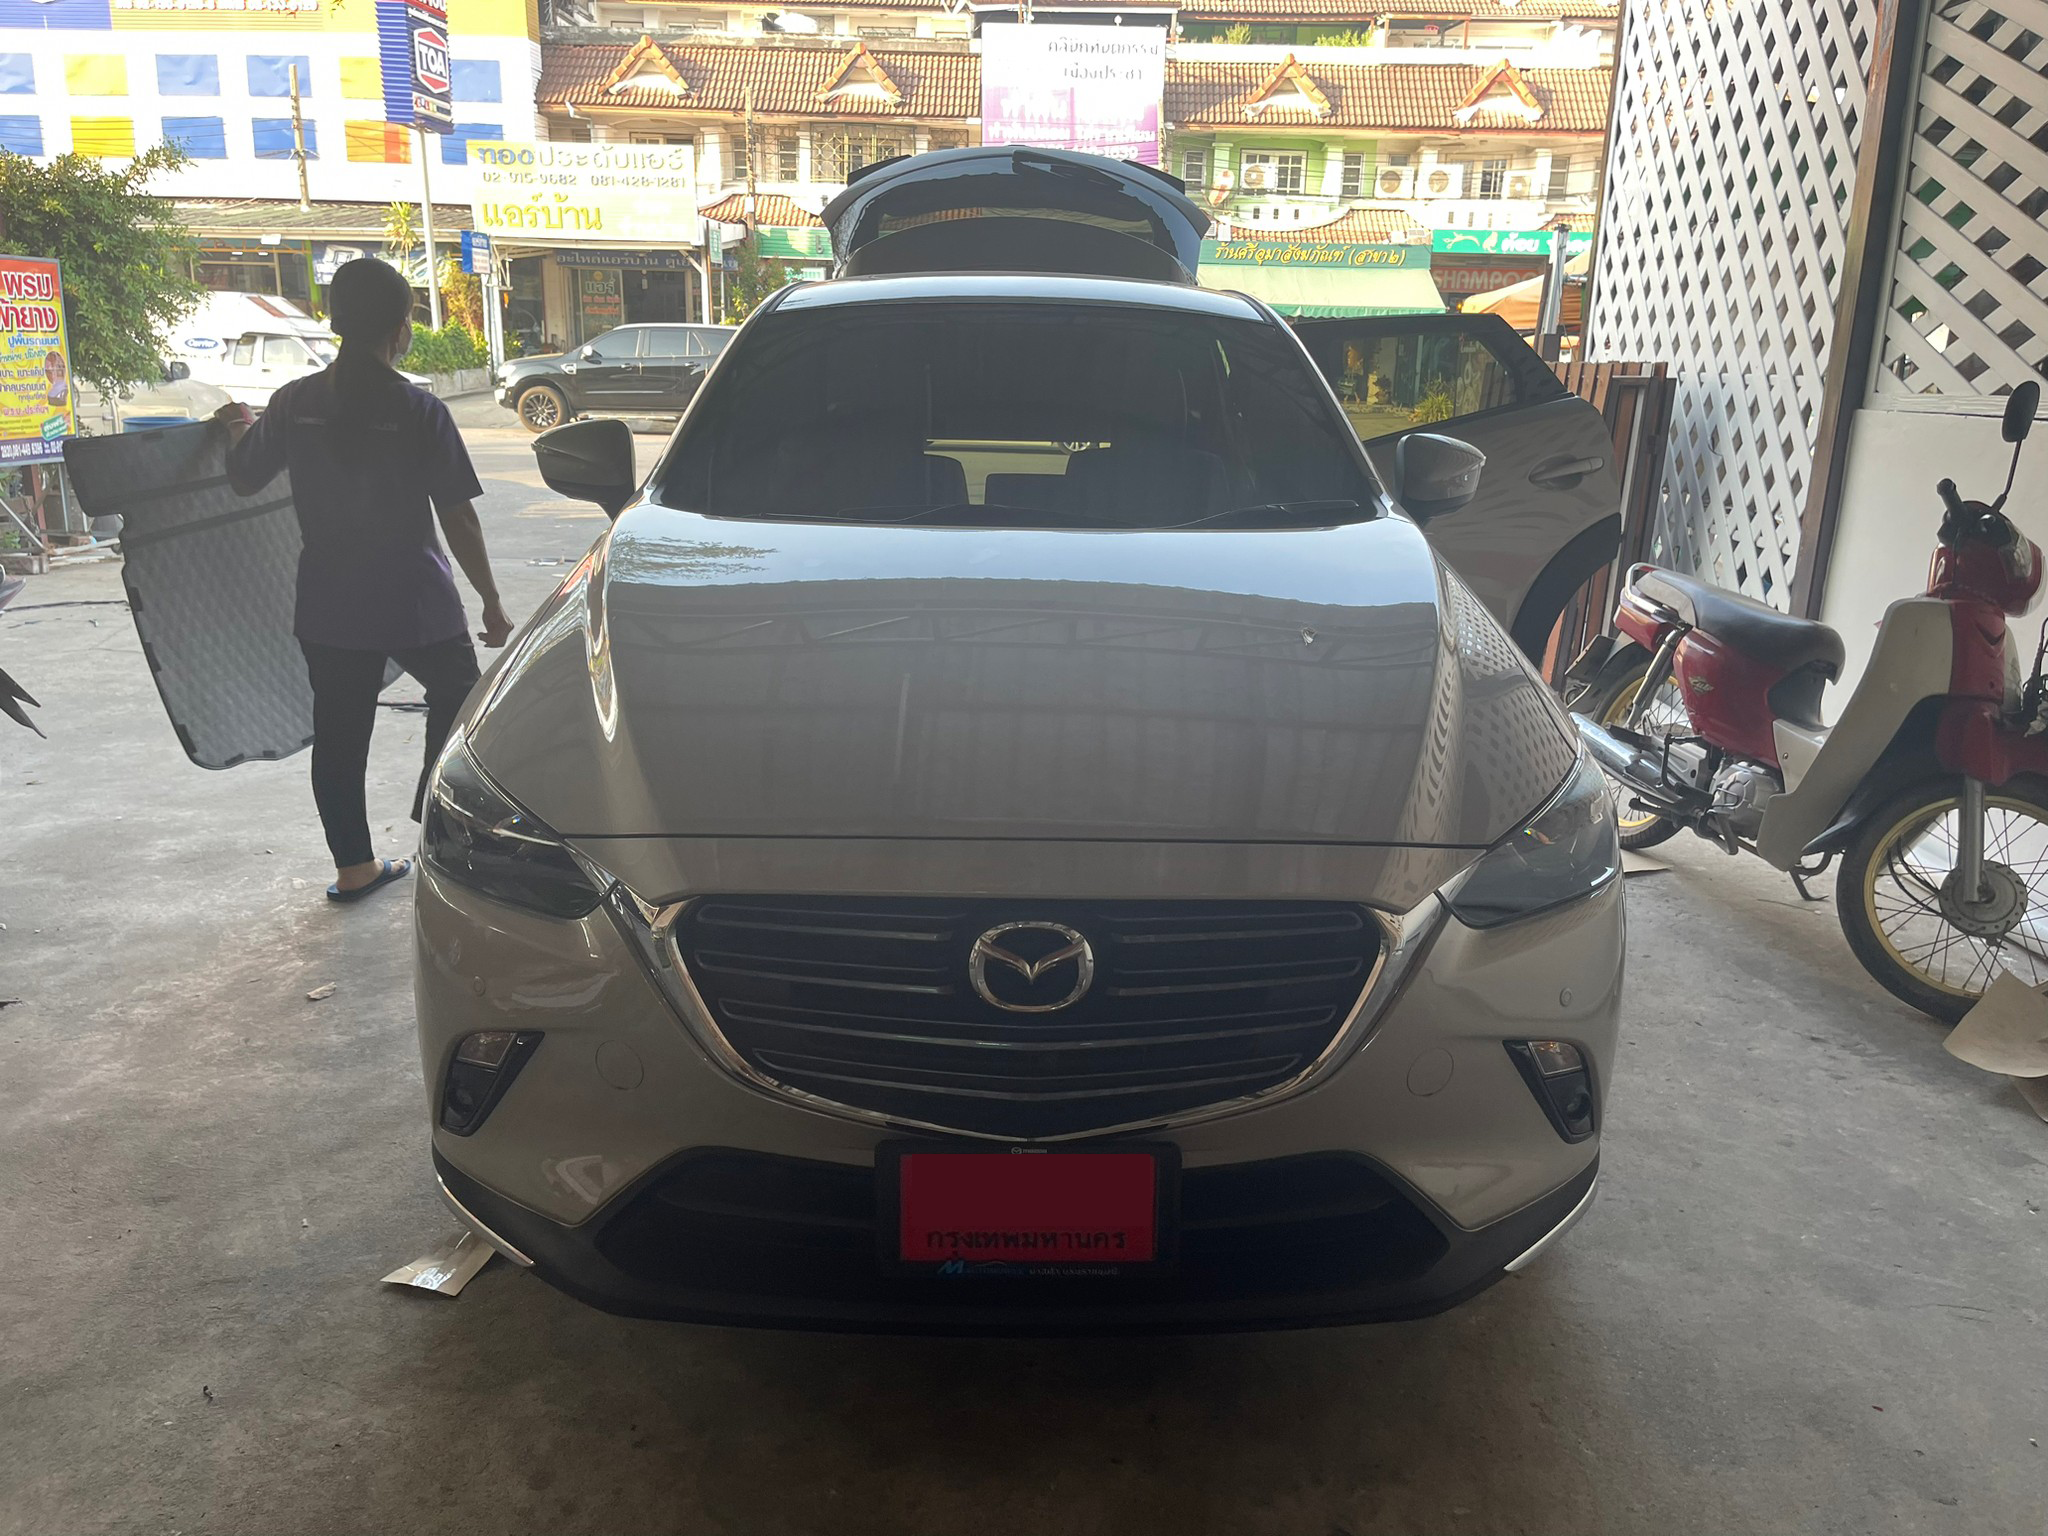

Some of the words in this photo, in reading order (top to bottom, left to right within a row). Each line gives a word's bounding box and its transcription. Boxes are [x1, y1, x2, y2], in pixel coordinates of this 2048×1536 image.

[419, 43, 447, 78] TOA
[482, 171, 577, 186] 02-915-9682
[482, 192, 603, 231] แอร์บ้าน
[2, 271, 54, 300] พรม
[926, 1230, 1127, 1257] กรุงเทพมหานคร
